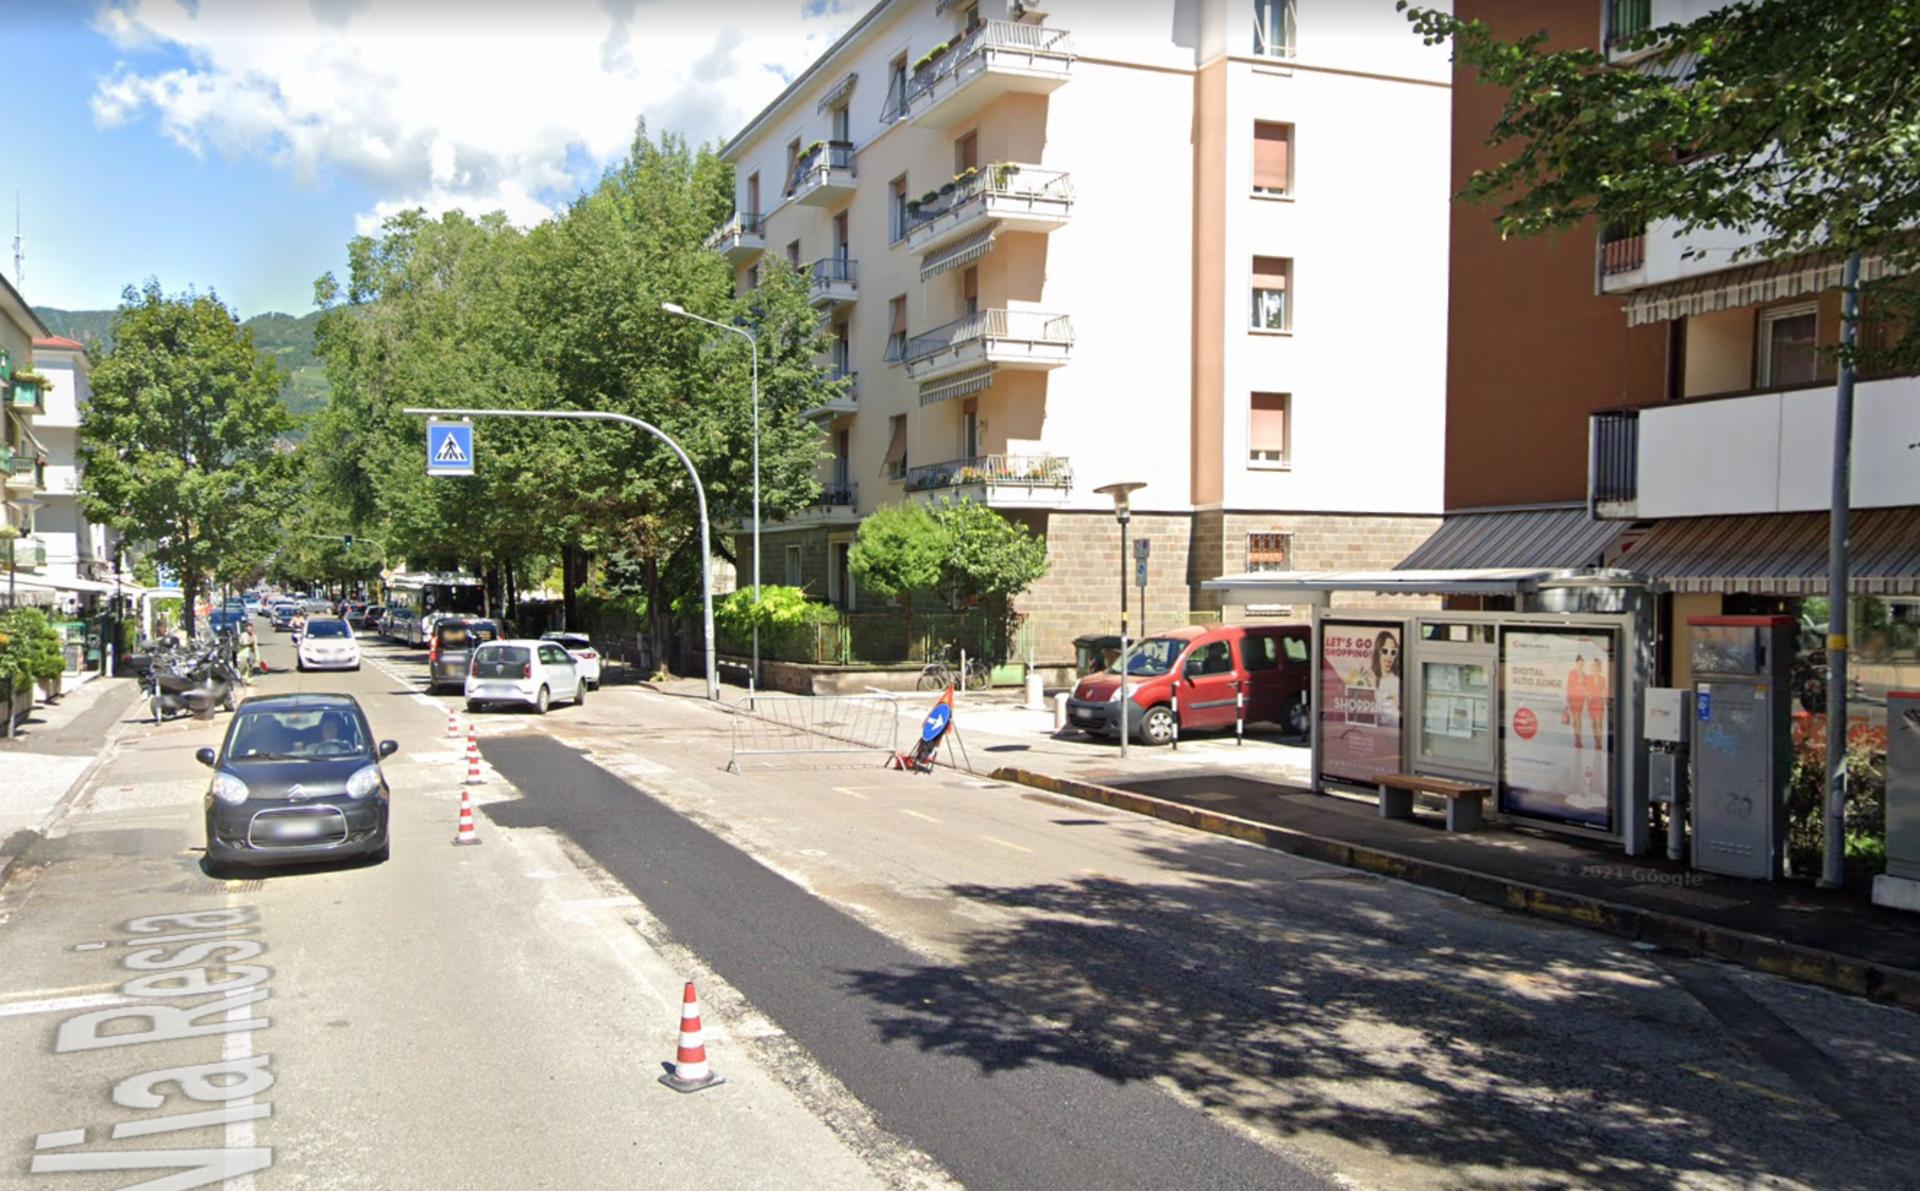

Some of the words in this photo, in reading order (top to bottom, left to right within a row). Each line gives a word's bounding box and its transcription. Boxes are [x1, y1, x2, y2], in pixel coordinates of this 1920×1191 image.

[1326, 636, 1352, 648] LET'S
[1356, 638, 1372, 649] GO
[1512, 666, 1545, 677] DIGITAL
